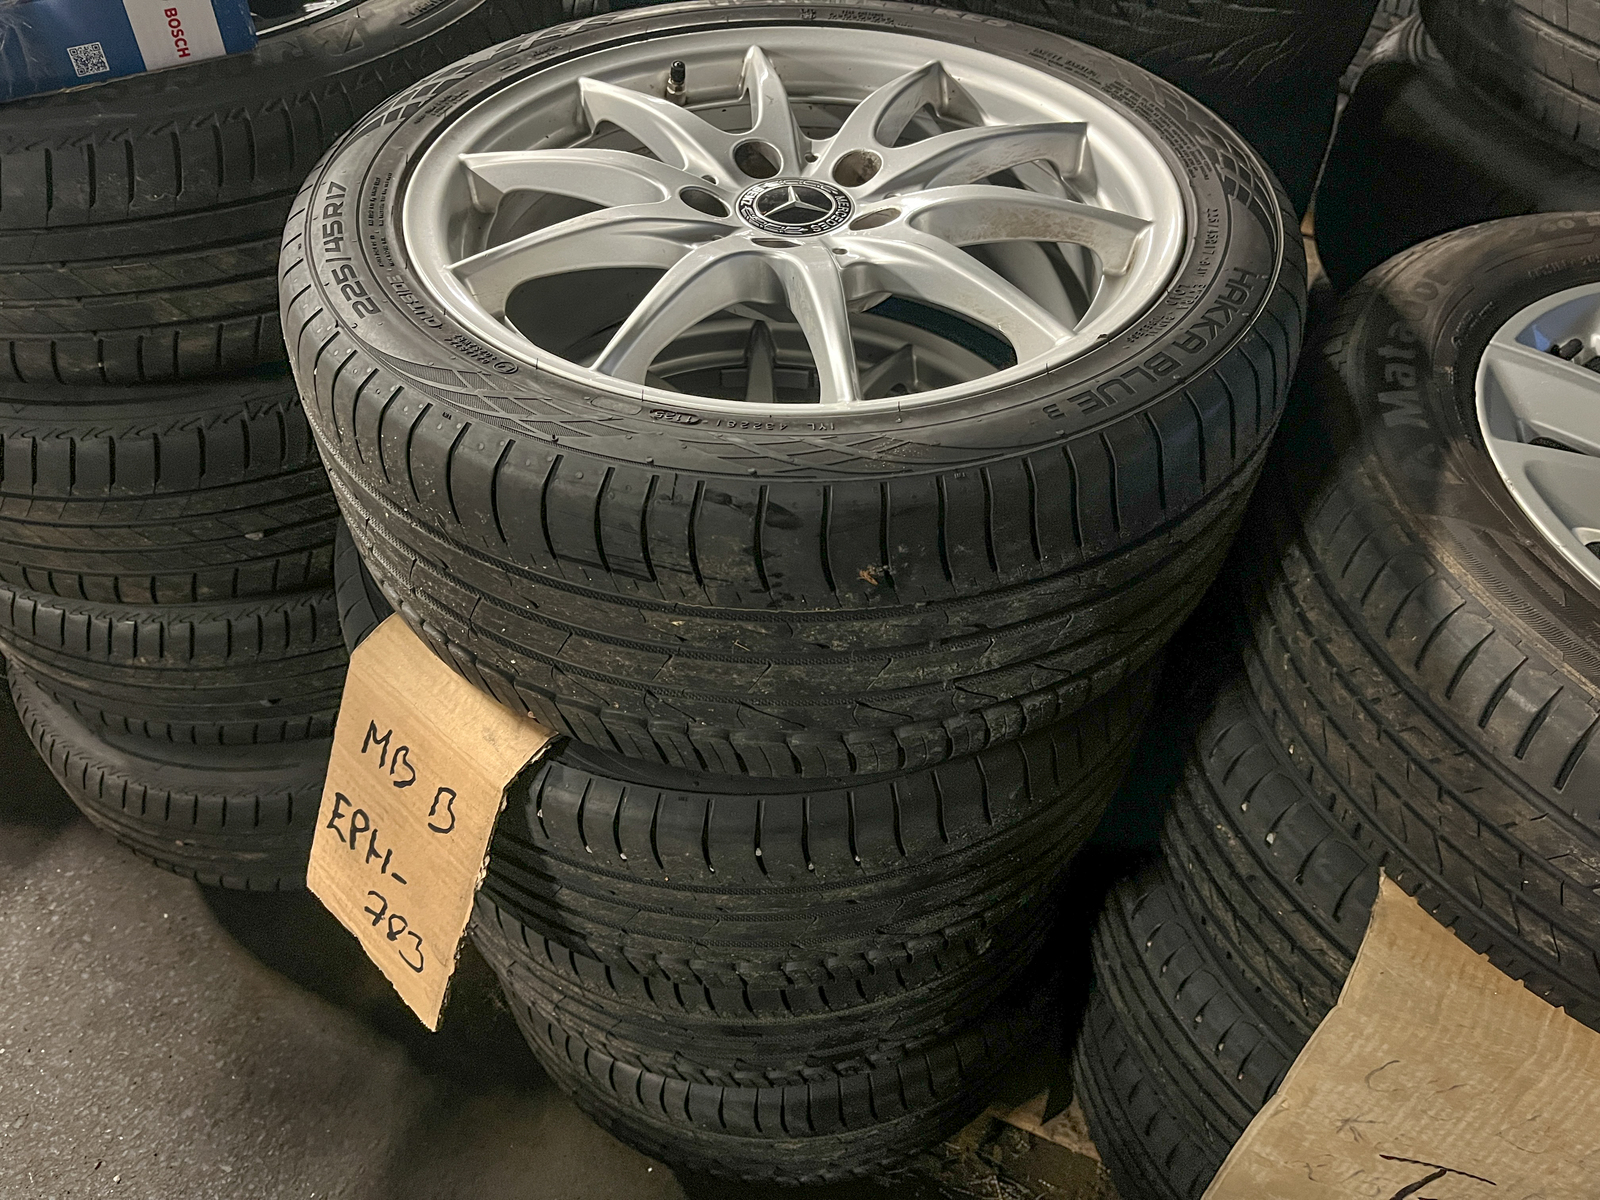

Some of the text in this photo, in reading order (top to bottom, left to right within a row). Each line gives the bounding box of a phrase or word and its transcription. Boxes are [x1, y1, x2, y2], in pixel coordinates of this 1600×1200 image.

[163, 6, 191, 59] BOSCH
[740, 185, 766, 207] BENZ
[810, 194, 852, 234] MERCEDES
[321, 180, 383, 320] 225/45R17
[1164, 284, 1191, 306] LOAD
[1041, 266, 1258, 420] HAKKA BLUE 3
[361, 719, 458, 834] MB B
[364, 889, 425, 973] 783
